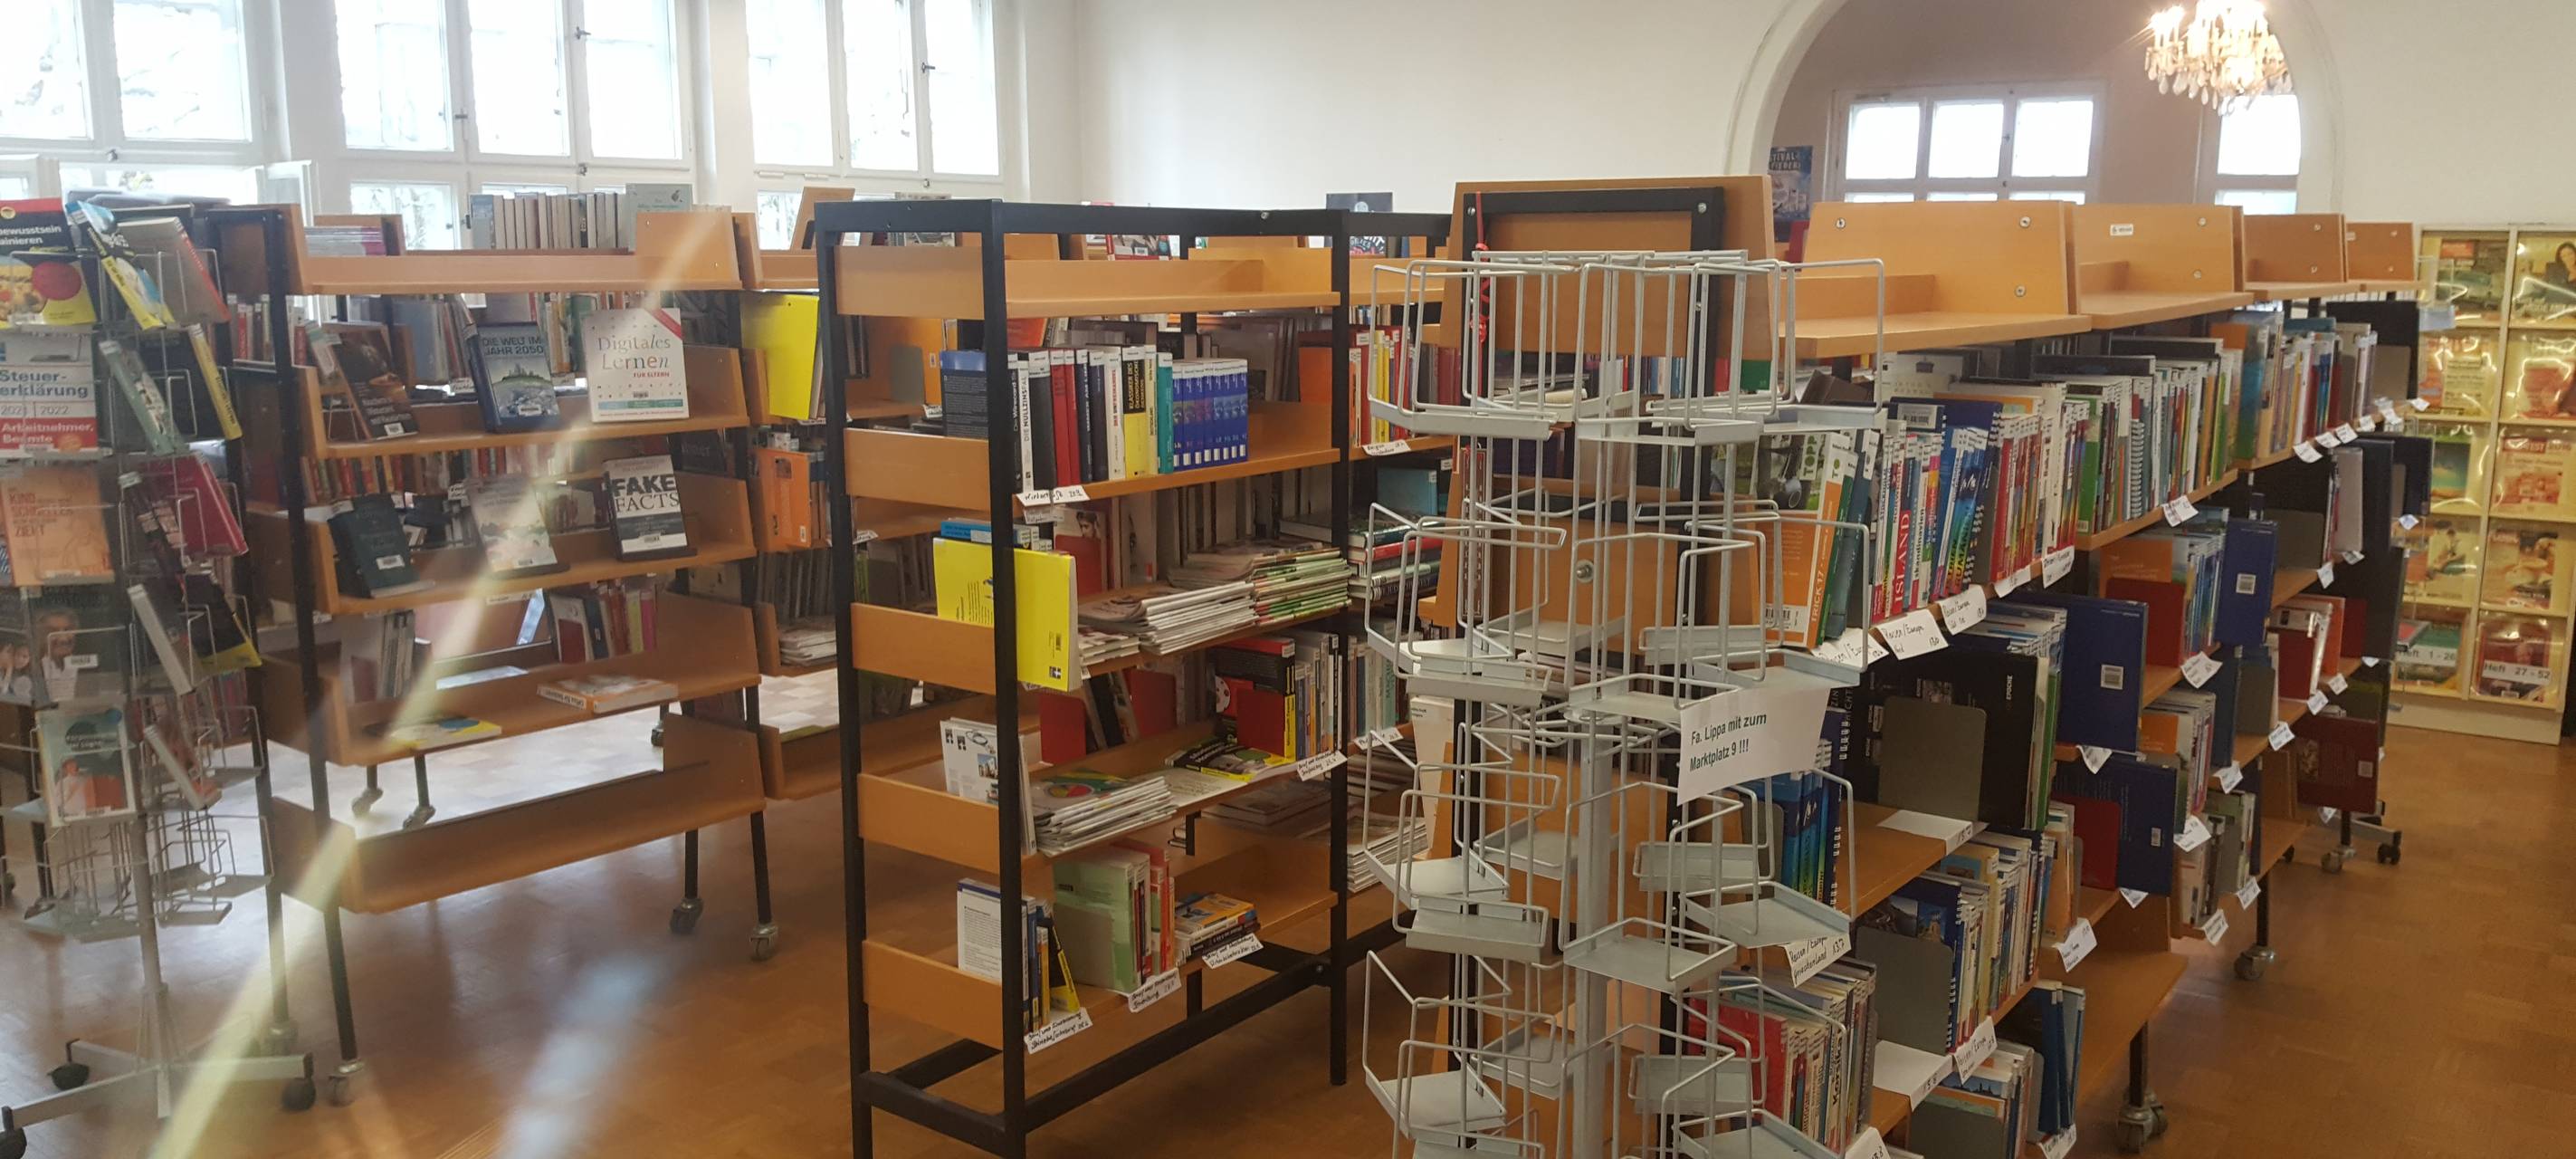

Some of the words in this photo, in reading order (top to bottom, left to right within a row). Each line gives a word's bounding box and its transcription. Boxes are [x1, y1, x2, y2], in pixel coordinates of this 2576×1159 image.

[482, 337, 497, 346] DIE
[528, 336, 543, 345] IM
[484, 345, 513, 355] JAHR
[515, 344, 544, 354] 2050
[598, 334, 671, 353] Digitales
[602, 354, 668, 369] Lernen
[0, 369, 67, 381] Steuer-
[0, 384, 88, 398] erklärung
[41, 406, 69, 415] 2022
[1021, 376, 1029, 427] NULLZINSFAL
[1803, 436, 1817, 476] TOPP
[611, 474, 676, 497] FAKE
[615, 493, 680, 512] FACTS
[1913, 508, 1924, 579] skandinavien
[1894, 512, 1910, 603] ISLAND
[1811, 586, 1823, 622] TRICK
[1818, 570, 1824, 582] 17
[2484, 663, 2505, 673] Heft
[2514, 667, 2529, 675] 27
[2538, 671, 2551, 679] 52
[1692, 731, 1703, 745] Fa.
[1704, 723, 1726, 741] Lippa
[1728, 718, 1741, 732] mit
[1743, 714, 1767, 727] zum
[1689, 746, 1730, 771] Marktplatz
[1732, 743, 1737, 756] 9
[1739, 738, 1749, 753] !!!
